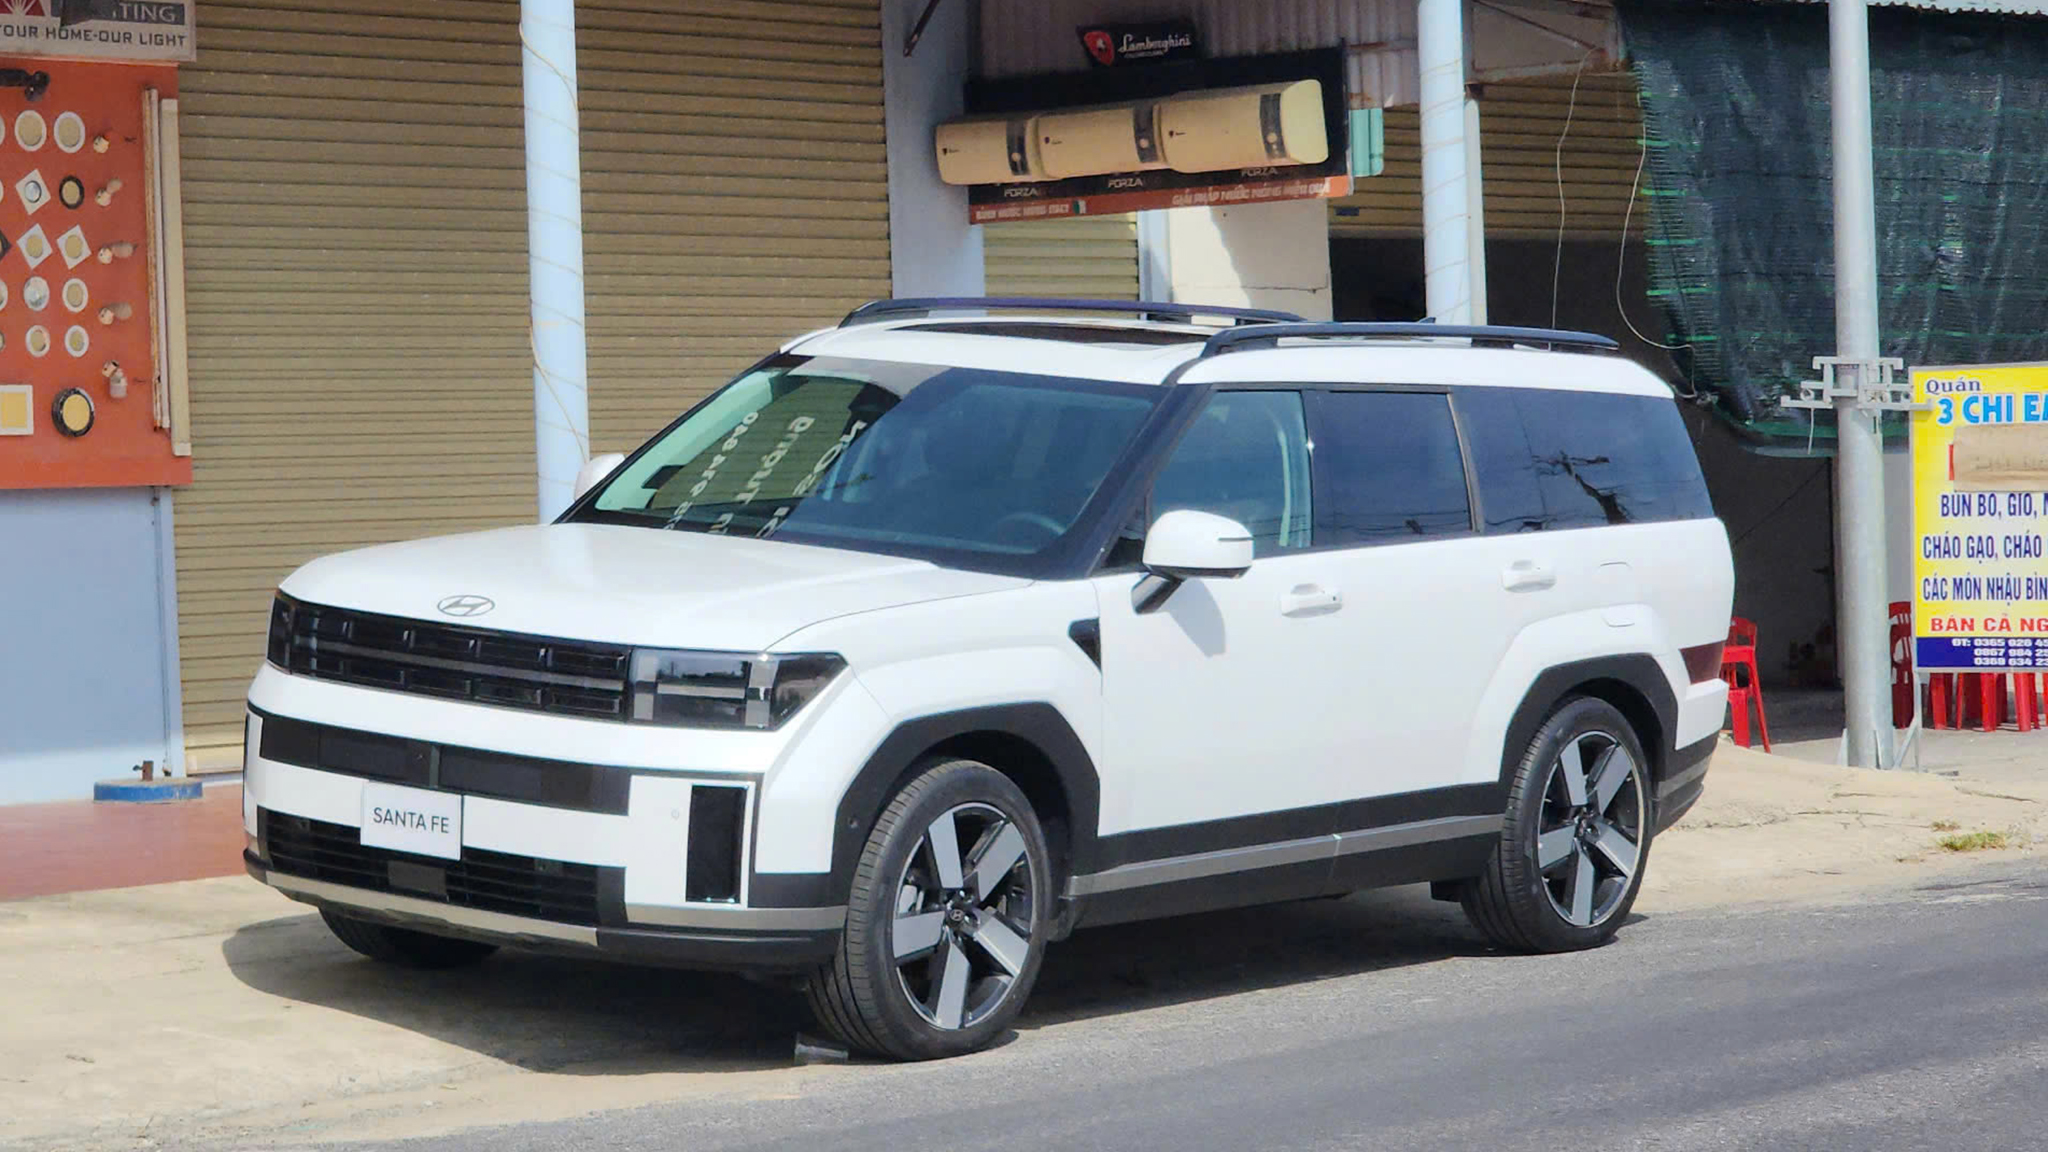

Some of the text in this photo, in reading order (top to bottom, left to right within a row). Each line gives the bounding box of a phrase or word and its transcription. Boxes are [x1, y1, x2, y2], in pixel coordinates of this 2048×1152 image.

[0, 24, 39, 38] OUR
[139, 33, 187, 46] LIGHT
[1118, 33, 1192, 53] Lamborghini
[1926, 377, 1981, 395] Quán
[1937, 398, 1954, 424] 3
[1923, 529, 2042, 564] CHÁO GẠO, CHÁO
[1923, 572, 1948, 601] CÁC
[1952, 572, 1982, 601] MÓN
[1986, 571, 2021, 606] NHẬU
[1930, 614, 1975, 632] BÁN
[373, 807, 449, 834] SANTA FE
